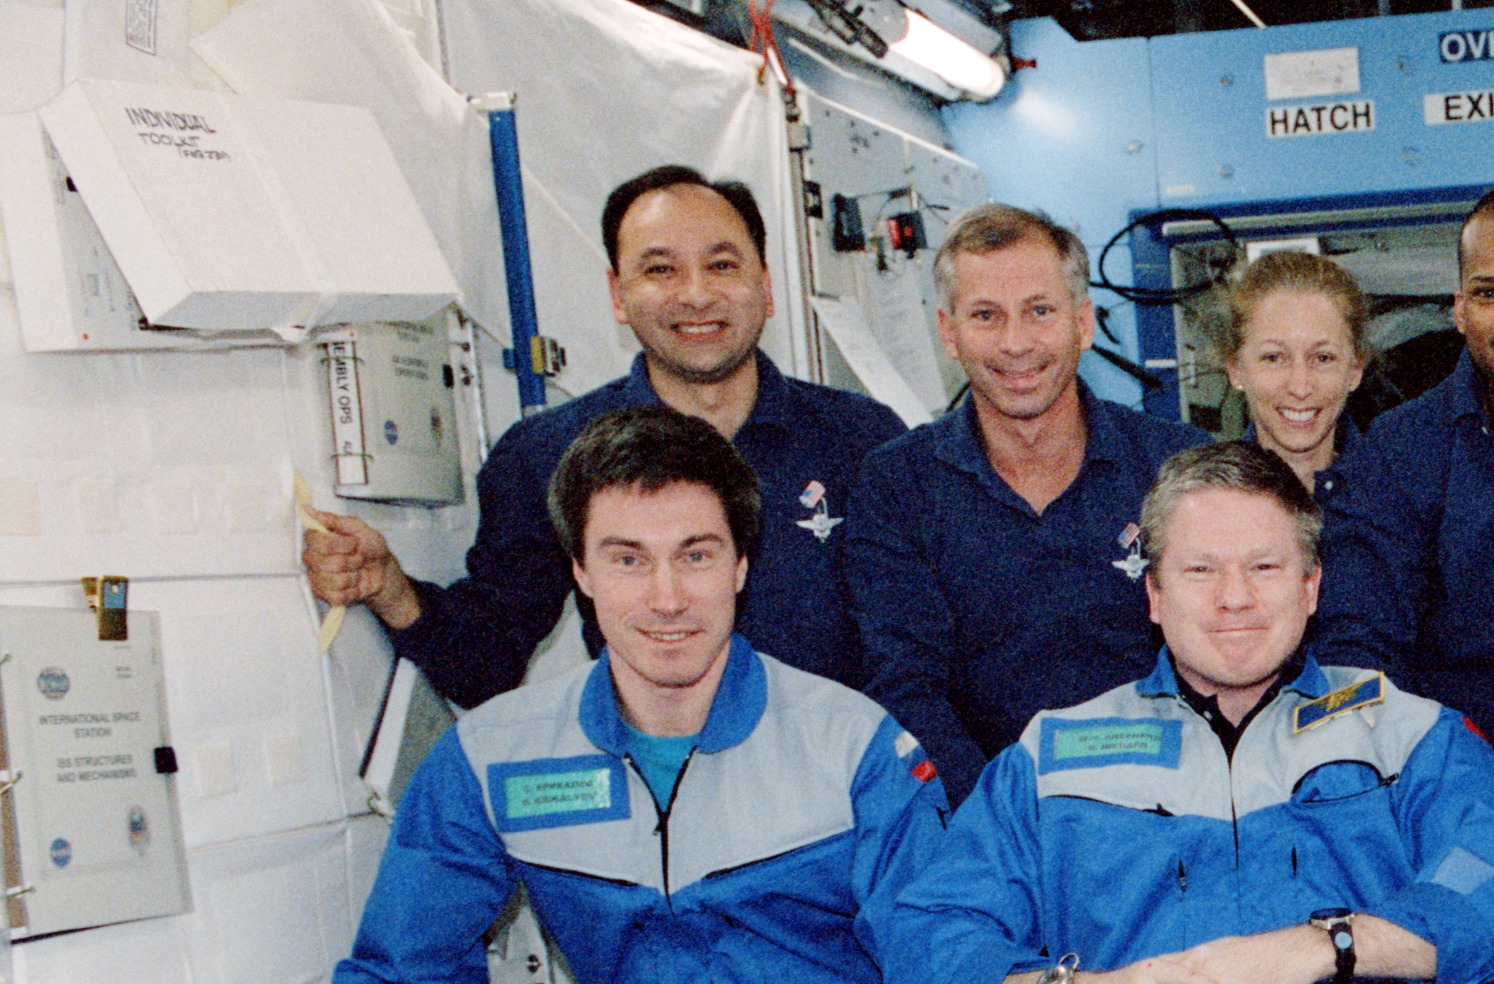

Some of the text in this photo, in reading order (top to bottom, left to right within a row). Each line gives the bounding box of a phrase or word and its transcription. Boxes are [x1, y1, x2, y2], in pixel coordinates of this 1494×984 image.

[125, 107, 217, 134] INDIVIDUAL
[1270, 102, 1372, 136] HATCH
[337, 395, 353, 424] OPS
[39, 711, 141, 724] INTERNATIONAL SPACE
[73, 728, 112, 739] STATION
[74, 755, 133, 766] STRUCTURES
[57, 769, 137, 782] AND MECHANISMS
